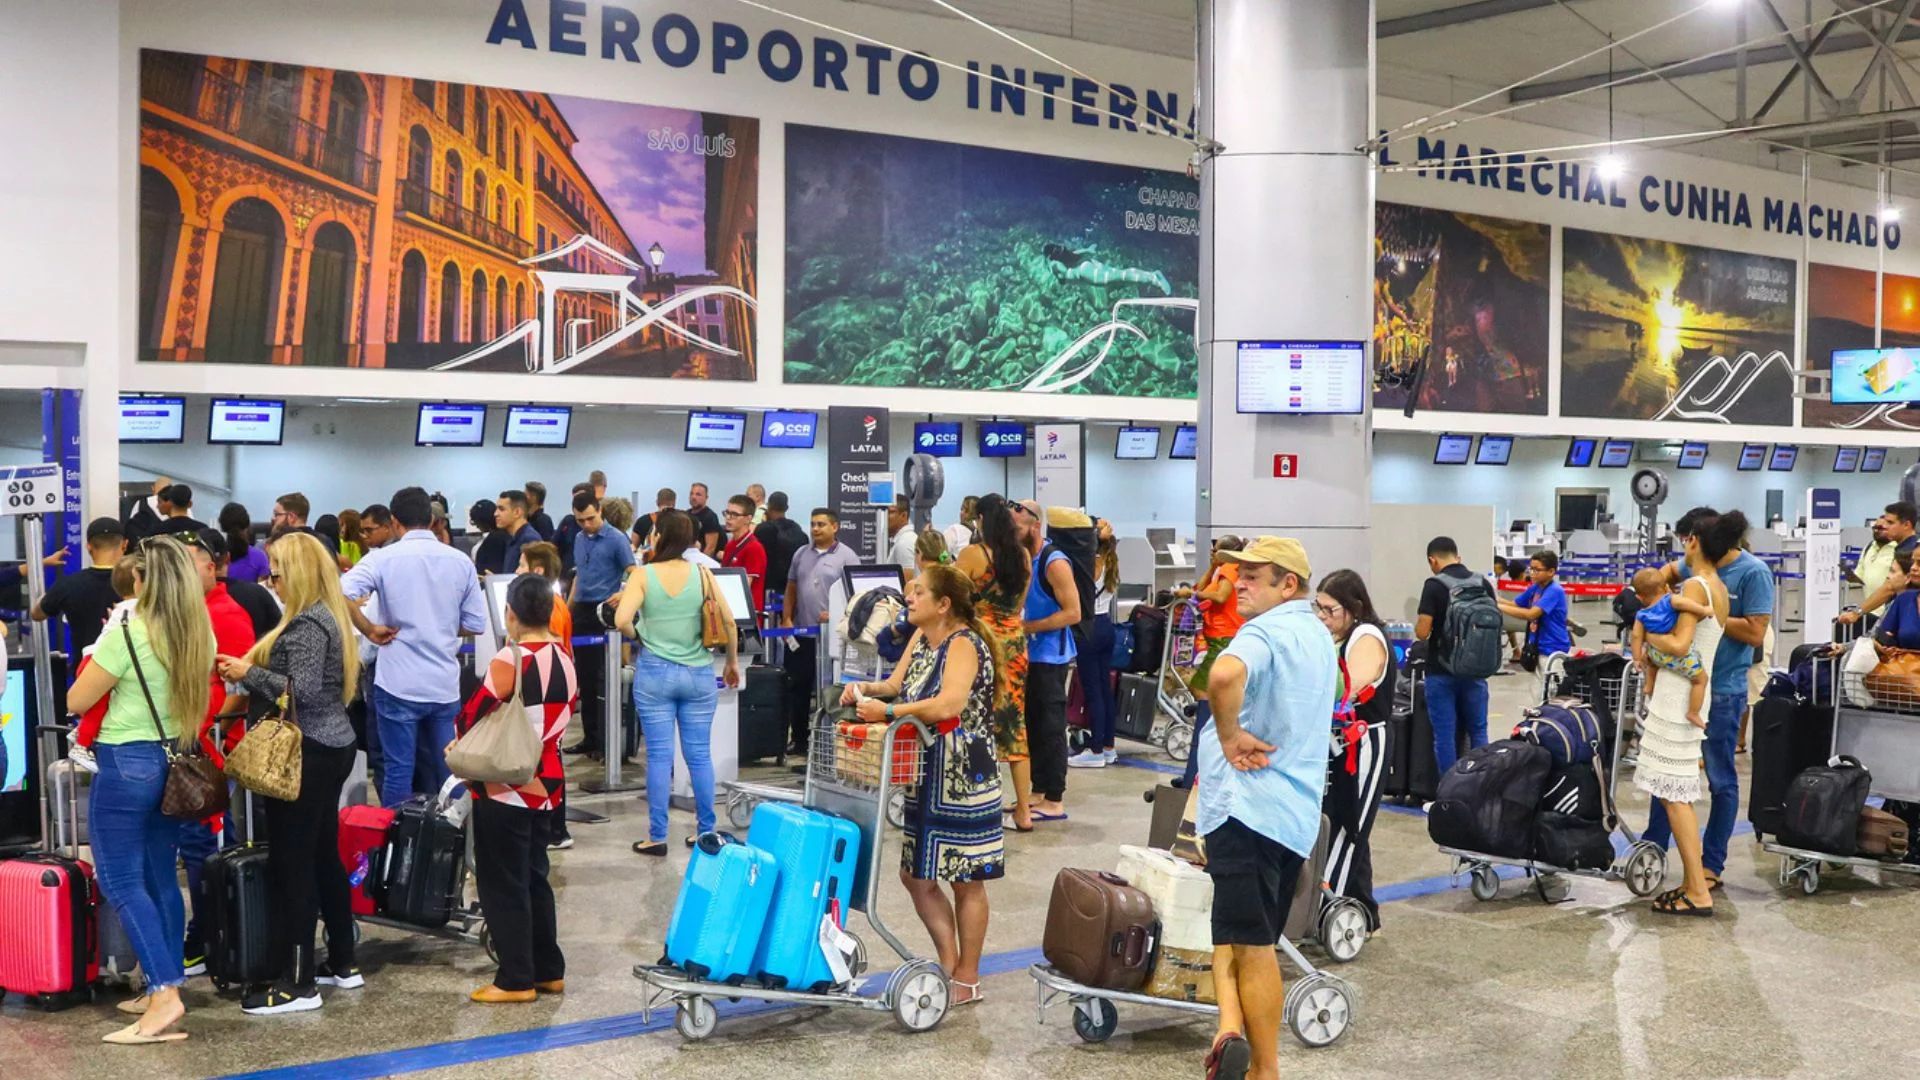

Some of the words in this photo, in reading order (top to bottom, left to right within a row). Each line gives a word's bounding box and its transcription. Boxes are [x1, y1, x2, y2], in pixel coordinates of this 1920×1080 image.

[485, 0, 940, 102] AEROPORTO
[647, 126, 690, 153] SÃO
[693, 132, 737, 158] LUÍS
[1418, 136, 1627, 208] MARECHAL
[1638, 175, 1753, 229] CUNHA
[1763, 196, 1902, 250] MACHADO
[1125, 210, 1156, 232] DAS
[1157, 214, 1200, 236] MESA
[786, 423, 811, 434] CCR
[935, 433, 958, 443] CCR
[1000, 433, 1022, 443] CCR
[850, 444, 884, 454] LATAM
[841, 472, 868, 482] Check
